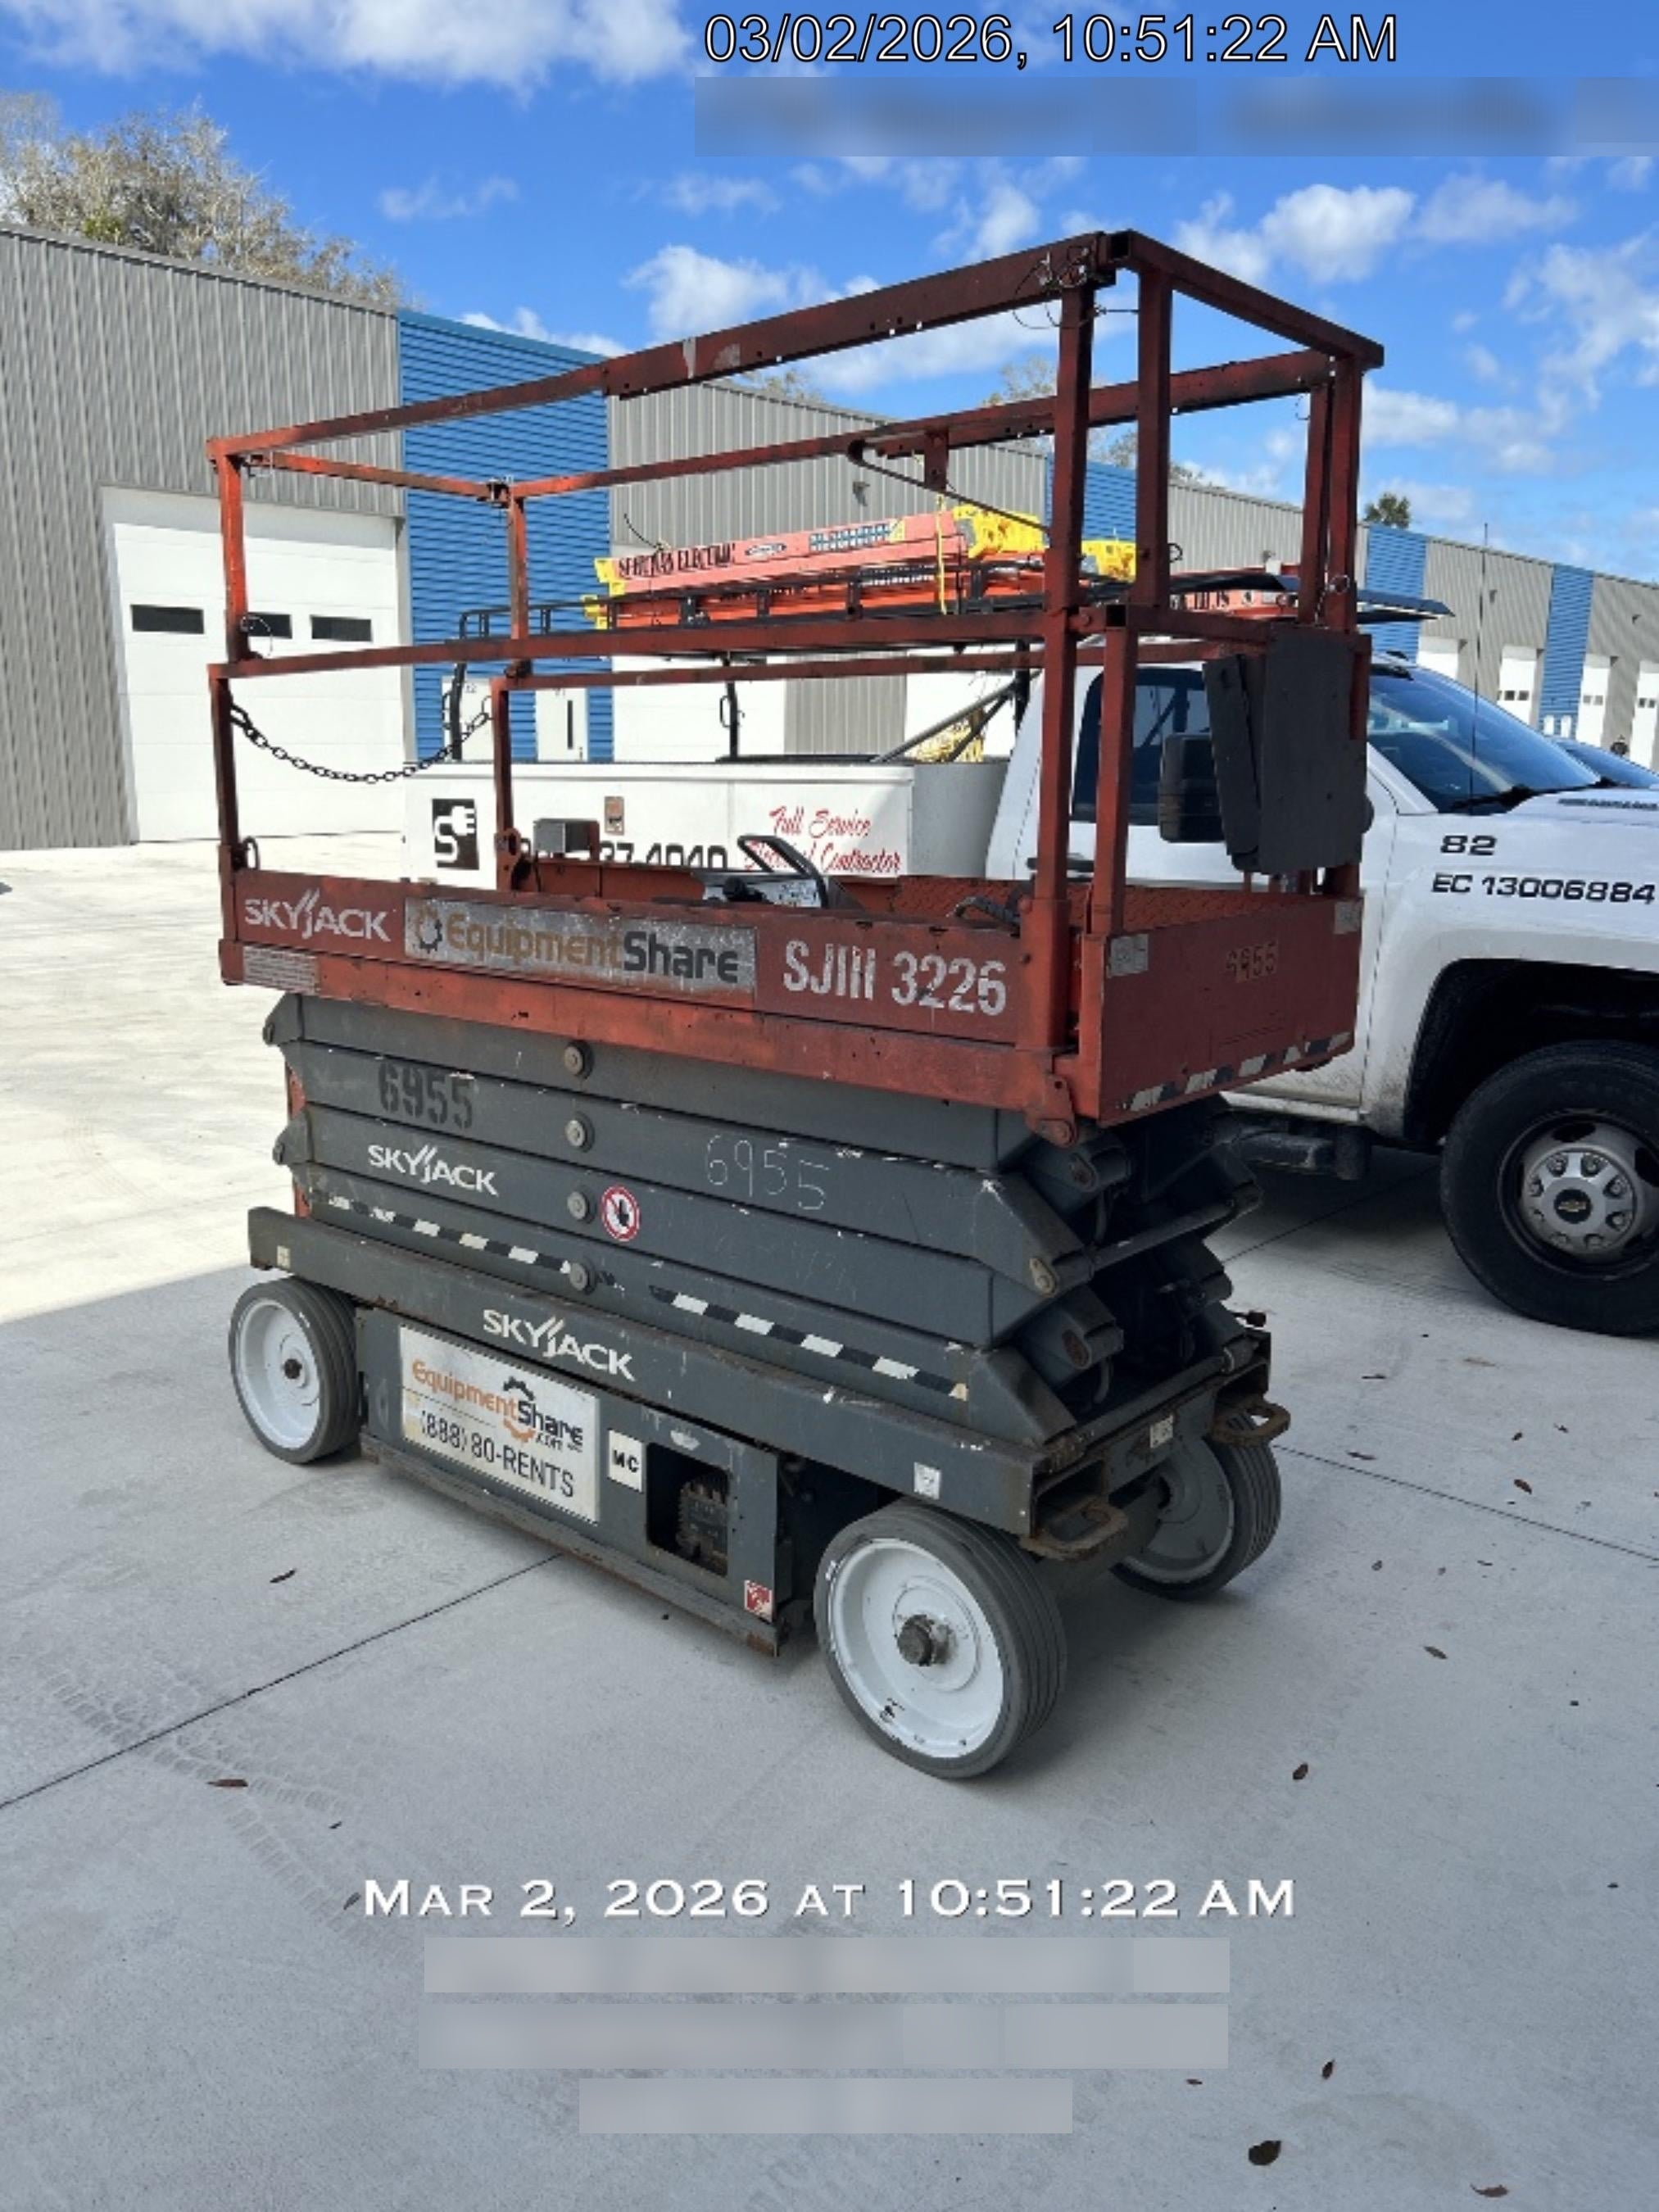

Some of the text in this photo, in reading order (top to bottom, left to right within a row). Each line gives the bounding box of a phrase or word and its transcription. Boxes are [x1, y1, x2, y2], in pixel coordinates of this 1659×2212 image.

[1439, 834, 1498, 856] 82
[244, 888, 392, 943] SKYJACK
[1431, 872, 1656, 905] EC 13006884
[446, 913, 740, 982] EquipmentShare
[377, 1063, 474, 1130] 6955
[367, 1144, 500, 1197] SKYJACK
[705, 1134, 832, 1211] 6955
[483, 1309, 637, 1381] SKYJACK
[470, 1431, 575, 1498] 80-RENTS
